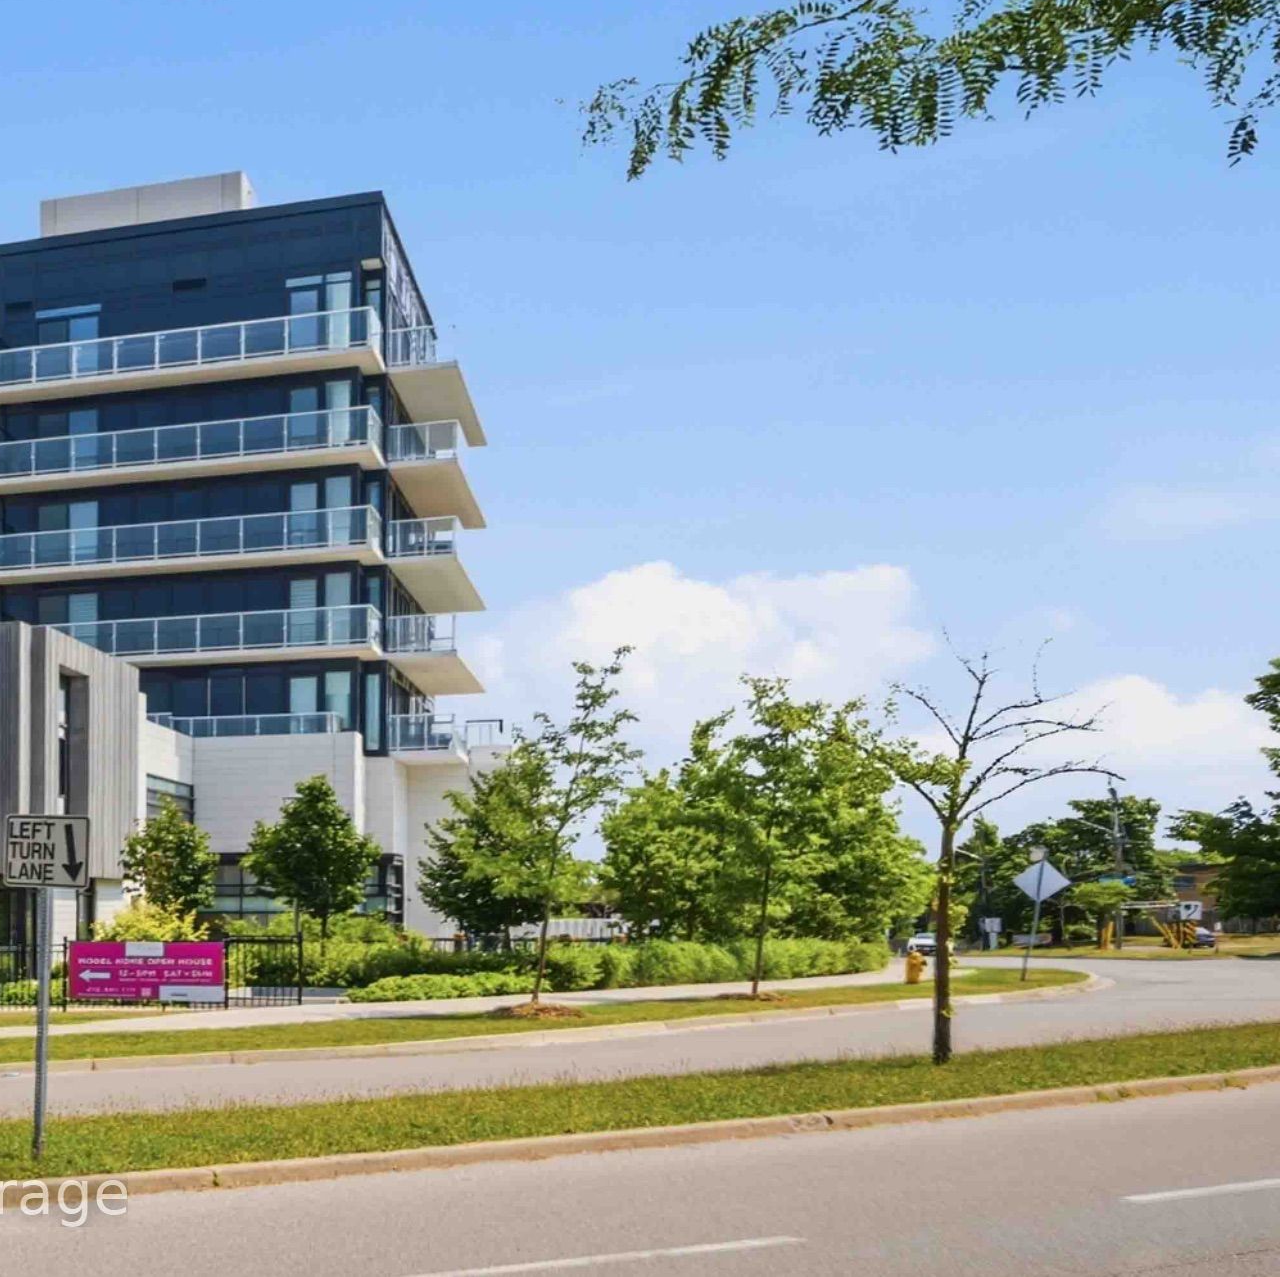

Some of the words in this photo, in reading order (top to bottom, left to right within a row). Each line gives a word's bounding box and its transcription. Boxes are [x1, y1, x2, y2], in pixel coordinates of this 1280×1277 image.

[10, 821, 56, 840] LEFT
[9, 841, 56, 860] TURN
[8, 861, 55, 881] LANE
